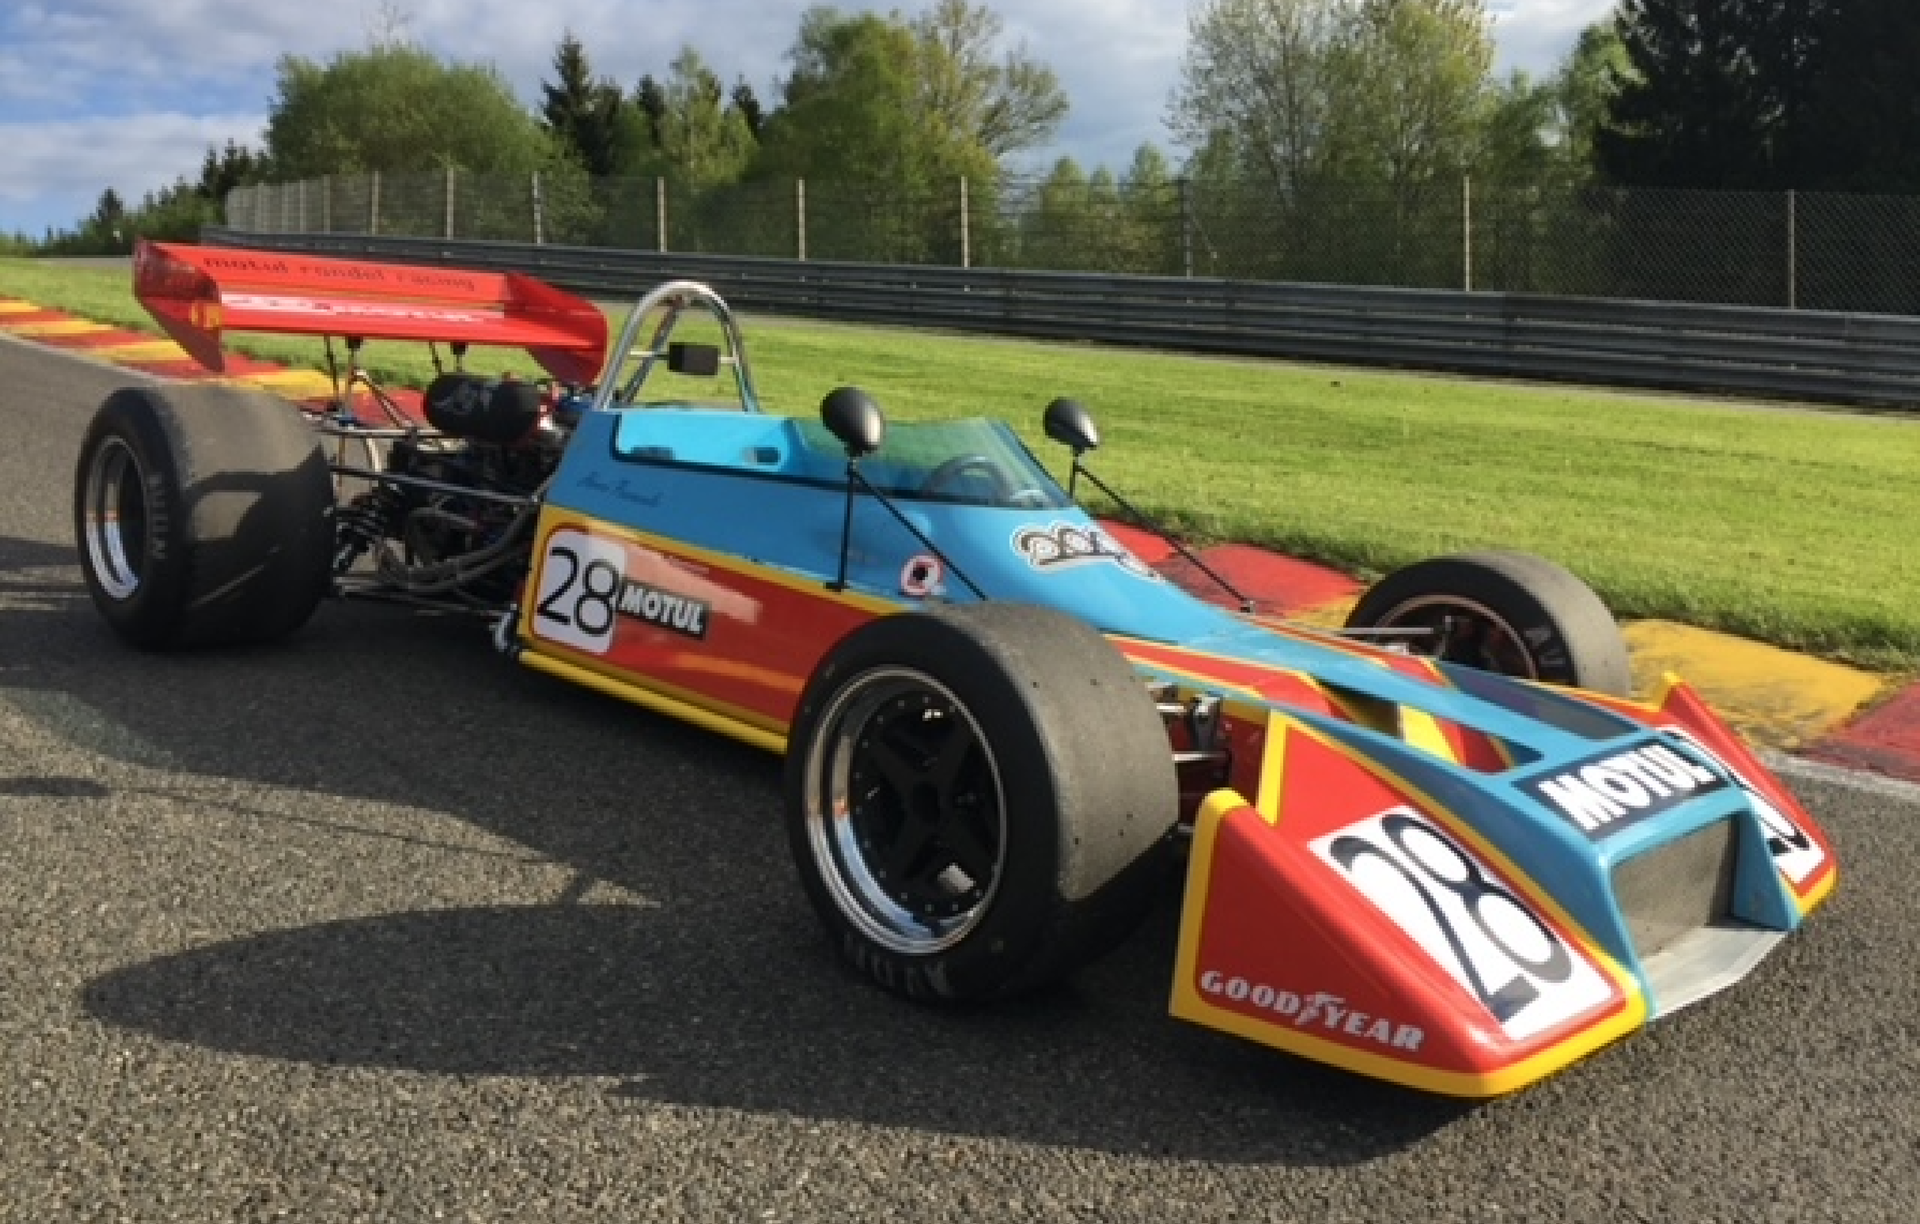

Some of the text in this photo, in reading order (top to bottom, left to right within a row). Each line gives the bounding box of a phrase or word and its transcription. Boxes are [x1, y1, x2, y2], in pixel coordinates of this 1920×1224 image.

[537, 546, 620, 637] 28
[620, 584, 705, 635] MOTUL
[1537, 744, 1716, 831] MOTUL
[1328, 812, 1572, 1023] 28
[1200, 970, 1425, 1051] GOODYEAR
